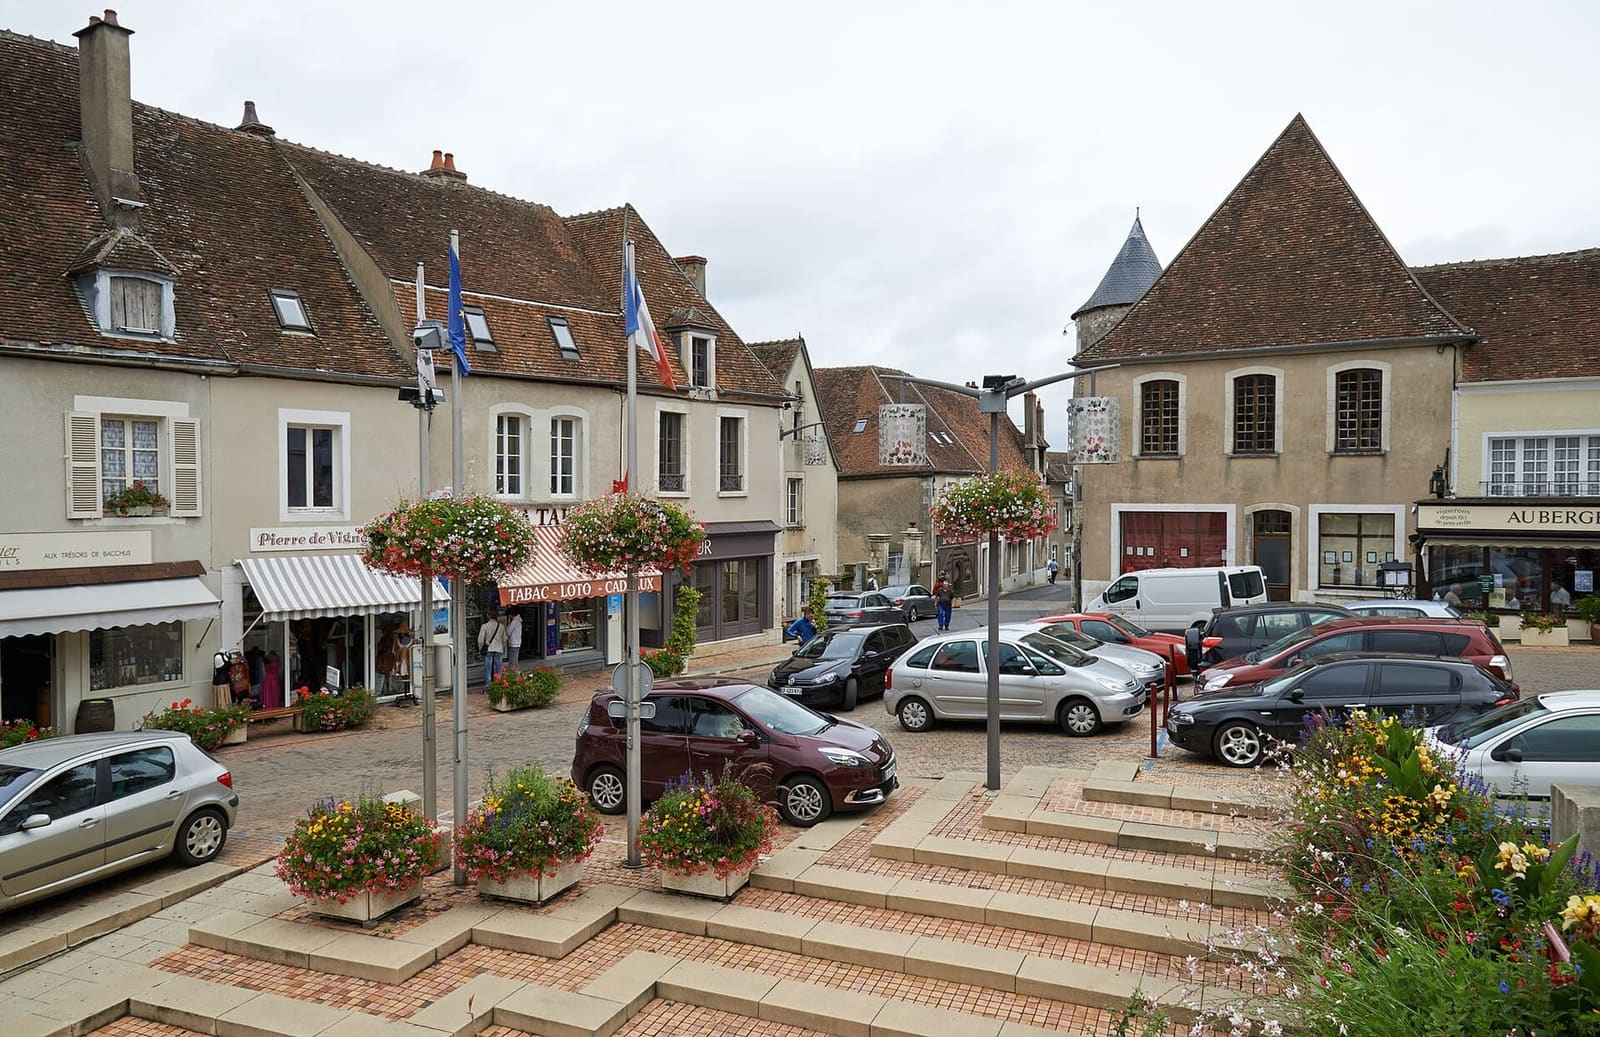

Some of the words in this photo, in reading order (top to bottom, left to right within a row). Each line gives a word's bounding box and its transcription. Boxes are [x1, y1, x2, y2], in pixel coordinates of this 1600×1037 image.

[1507, 511, 1600, 525] AUBERG
[257, 532, 306, 546] Pierre
[309, 532, 326, 545] de
[0, 545, 20, 557] ier
[43, 552, 58, 560] AUX
[103, 549, 131, 558] BACCHUS
[508, 586, 550, 602] TABAC
[560, 582, 592, 598] LOTO
[605, 577, 655, 594] CADUX
